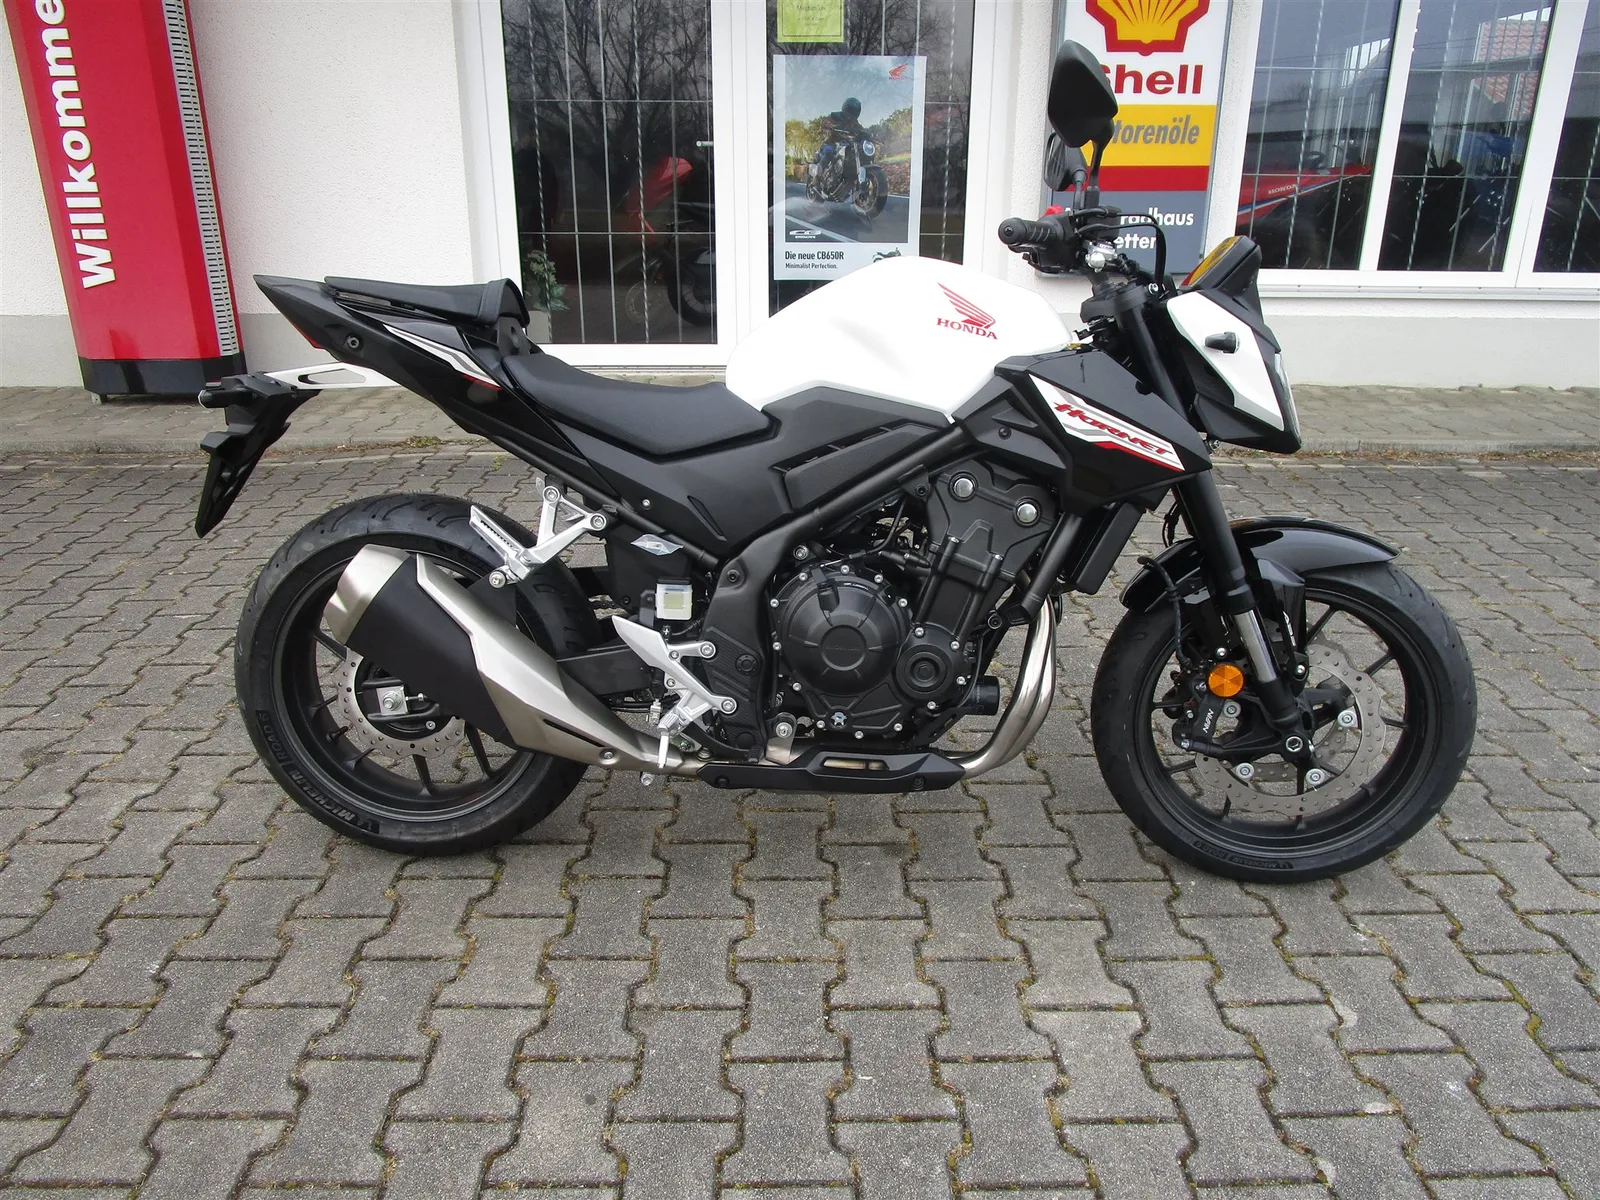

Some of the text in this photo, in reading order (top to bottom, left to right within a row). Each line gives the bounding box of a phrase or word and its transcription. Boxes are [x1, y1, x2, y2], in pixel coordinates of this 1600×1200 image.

[1112, 115, 1200, 145] torenöle
[1114, 233, 1157, 249] etter
[785, 251, 845, 260] Die neue CB650R
[936, 317, 998, 340] HONDA
[263, 724, 289, 763] ROAD
[288, 768, 356, 821] MICHELIN
